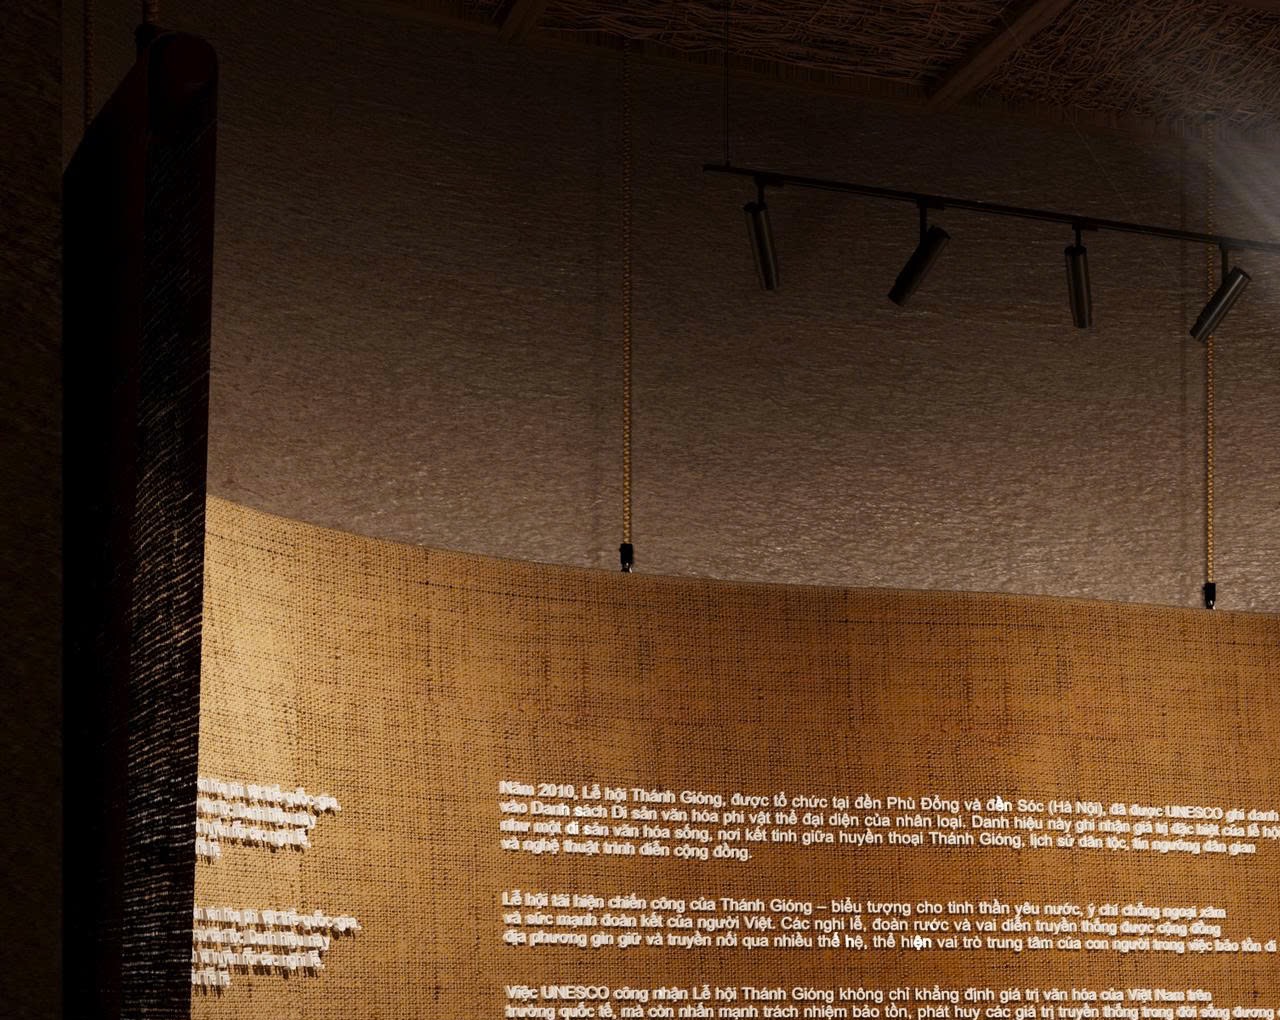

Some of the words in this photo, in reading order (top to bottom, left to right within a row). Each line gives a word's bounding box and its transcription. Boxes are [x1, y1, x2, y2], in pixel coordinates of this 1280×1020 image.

[537, 784, 579, 803] 2010,
[630, 788, 676, 803] Thánh
[679, 790, 726, 809] Gióng,
[730, 792, 770, 810] được
[773, 790, 788, 807] tổ
[791, 794, 828, 808] chức
[832, 795, 850, 812] tại
[854, 792, 882, 809] đền
[887, 796, 916, 810] Phù
[920, 794, 960, 815] Đổng
[964, 797, 982, 812] và
[986, 795, 1013, 812] đền
[1017, 799, 1045, 813] Sóc
[1047, 800, 1073, 818] (Hà
[1164, 806, 1224, 820] UNESCO
[661, 807, 688, 822] văn
[691, 808, 719, 822] hóa
[723, 809, 745, 827] phi
[748, 810, 771, 828] vật
[775, 807, 798, 825] thể
[802, 812, 824, 829] đại
[828, 812, 859, 830] diện
[864, 813, 891, 827] của
[896, 814, 932, 828] nhân
[937, 815, 966, 833] loại.
[971, 815, 1010, 829] Danh
[1013, 815, 1044, 834] hiệu
[1047, 816, 1072, 834] này
[642, 824, 671, 839] hóa
[674, 823, 713, 844] sống,
[717, 827, 741, 841] nơi
[745, 825, 767, 842] kết
[771, 829, 797, 842] tinh
[801, 829, 834, 847] giữa
[839, 826, 883, 848] huyền
[888, 831, 924, 848] thoại
[929, 831, 975, 845] Thánh
[979, 832, 1025, 850] Gióng,
[1029, 833, 1053, 851] lịch
[1056, 833, 1075, 848] sử
[638, 839, 670, 856] diễn
[673, 843, 709, 862] cộng
[712, 841, 752, 863] đồng.
[650, 896, 686, 915] công
[689, 897, 716, 911] của
[719, 898, 765, 912] Thánh
[769, 898, 813, 916] Gióng
[831, 896, 862, 913] biểu
[867, 900, 912, 918] tượng
[916, 900, 943, 914] cho
[947, 901, 974, 914] tinh
[978, 898, 1010, 915] thần
[1014, 901, 1040, 919] yêu
[1043, 901, 1084, 920] nước,
[640, 911, 664, 928] kết
[666, 914, 693, 929] của
[697, 915, 740, 933] người
[744, 916, 776, 934] Việt.
[780, 916, 810, 930] Các
[814, 917, 845, 934] nghi
[850, 914, 867, 935] lễ,
[872, 917, 909, 931] đoàn
[913, 917, 949, 931] rước
[953, 917, 971, 931] và
[975, 918, 997, 931] vai
[1001, 915, 1032, 932] diễn
[1035, 915, 1078, 936] truyền
[645, 932, 664, 946] và
[667, 929, 712, 951] truyền
[716, 930, 738, 947] nối
[742, 937, 769, 951] qua
[773, 930, 813, 948] nhiều
[817, 931, 841, 948] thế
[844, 934, 868, 952] hệ,
[872, 931, 896, 948] thể
[901, 934, 932, 952] hiện
[936, 935, 958, 949] vai
[962, 935, 982, 949] trò
[986, 935, 1023, 953] trung
[1027, 935, 1054, 949] tâm
[1056, 935, 1082, 950] của
[540, 986, 610, 1000] UNESCO
[652, 986, 689, 1004] nhận
[692, 983, 711, 1000] Lễ
[715, 986, 737, 1004] hội
[741, 986, 787, 1000] Thánh
[791, 987, 834, 1005] Gióng
[839, 987, 884, 1005] không
[888, 987, 910, 1001] chỉ
[915, 984, 960, 1005] khẳng
[964, 988, 995, 1005] định
[999, 987, 1021, 1005] giá
[1025, 987, 1039, 1005] trị
[1043, 987, 1068, 1001] văn
[647, 1004, 675, 1018] còn
[678, 1001, 714, 1018] nhấn
[763, 1004, 799, 1018] trách
[852, 1004, 880, 1018] bảo
[985, 1004, 1011, 1018] các
